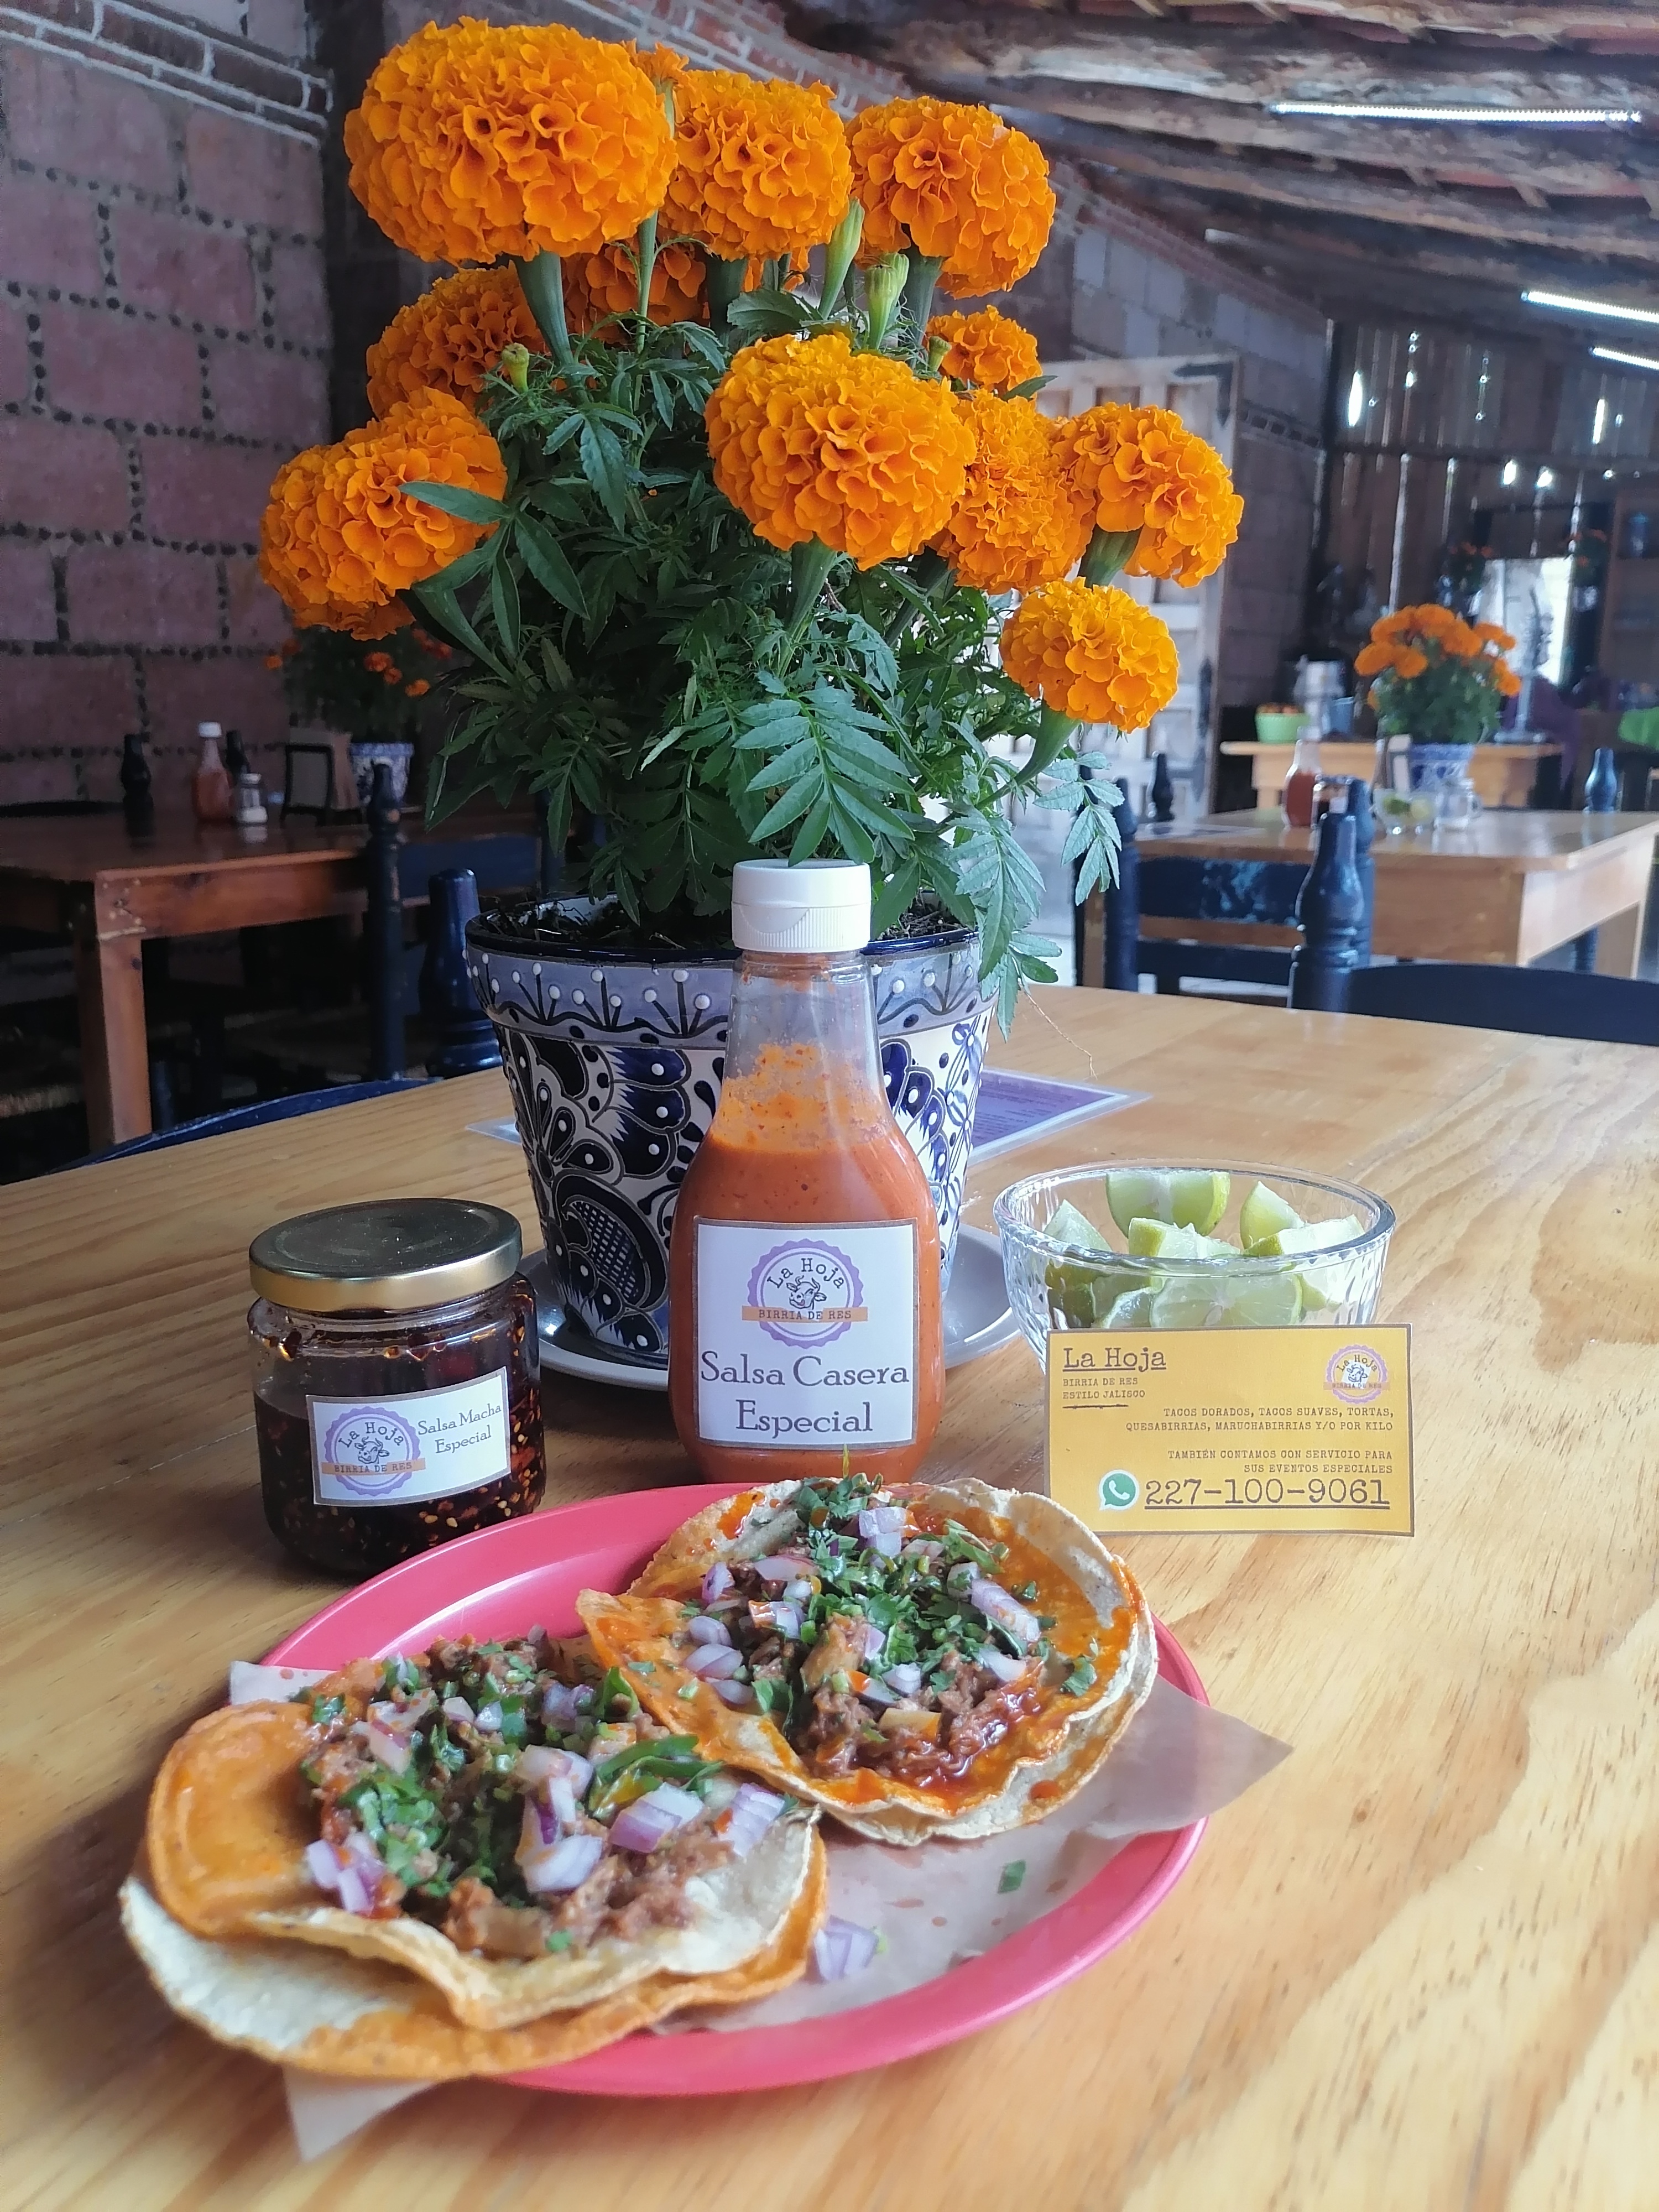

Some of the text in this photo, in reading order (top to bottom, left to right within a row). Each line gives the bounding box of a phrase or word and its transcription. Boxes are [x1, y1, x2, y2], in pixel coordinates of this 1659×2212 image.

[767, 1258, 845, 1288] La Hoja
[759, 1310, 852, 1320] BIRRIA DE RES
[701, 1350, 910, 1386] Salsa Casera
[1063, 1347, 1166, 1372] La Hoja
[1336, 1354, 1378, 1372] La Hoja
[1062, 1378, 1098, 1386] BIRRIA
[1119, 1377, 1138, 1385] RES
[1062, 1390, 1145, 1399] ESTILO JALISCO
[418, 1402, 502, 1436] Salsa Macha
[735, 1399, 873, 1438] Especial
[1164, 1407, 1394, 1417] TACOS DORADOS, TACOS SUAVES, TORTAS,
[338, 1422, 404, 1448] La Hoja
[1126, 1421, 1393, 1432] QUESABIRRIAS, MARUCHABIRRIAS Y/O POR KILO
[435, 1425, 492, 1454] Especial
[1168, 1448, 1392, 1459] TAMBIÉN CONTAMOS CON SERVICIO PARA
[334, 1462, 413, 1473] BIRRIA DE RES
[1244, 1464, 1392, 1473] SUS EVENTOS ESPECIALES
[1145, 1478, 1390, 1506] 227-100-9061
